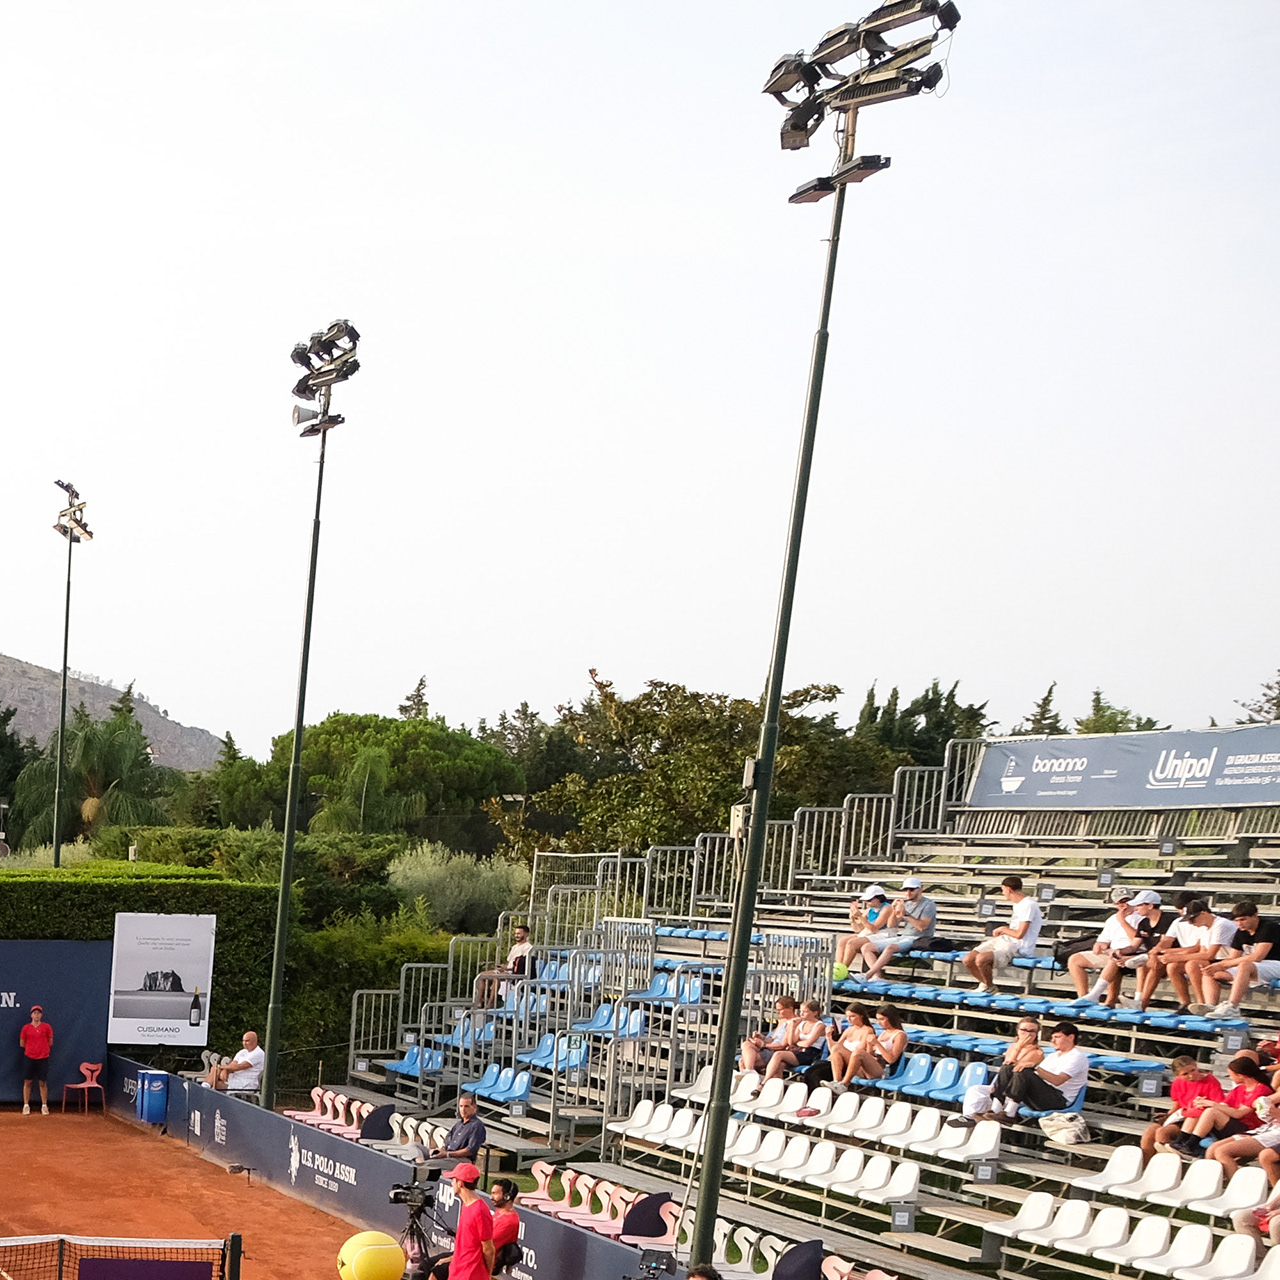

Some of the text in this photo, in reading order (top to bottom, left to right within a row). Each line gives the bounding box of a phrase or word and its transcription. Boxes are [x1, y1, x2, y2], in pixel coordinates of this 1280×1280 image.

[1032, 755, 1088, 773] bonanno
[1154, 747, 1218, 788] Unipol
[137, 1026, 180, 1034] CUSUMANO
[301, 1148, 357, 1186] U.S. POLO ASSN.
